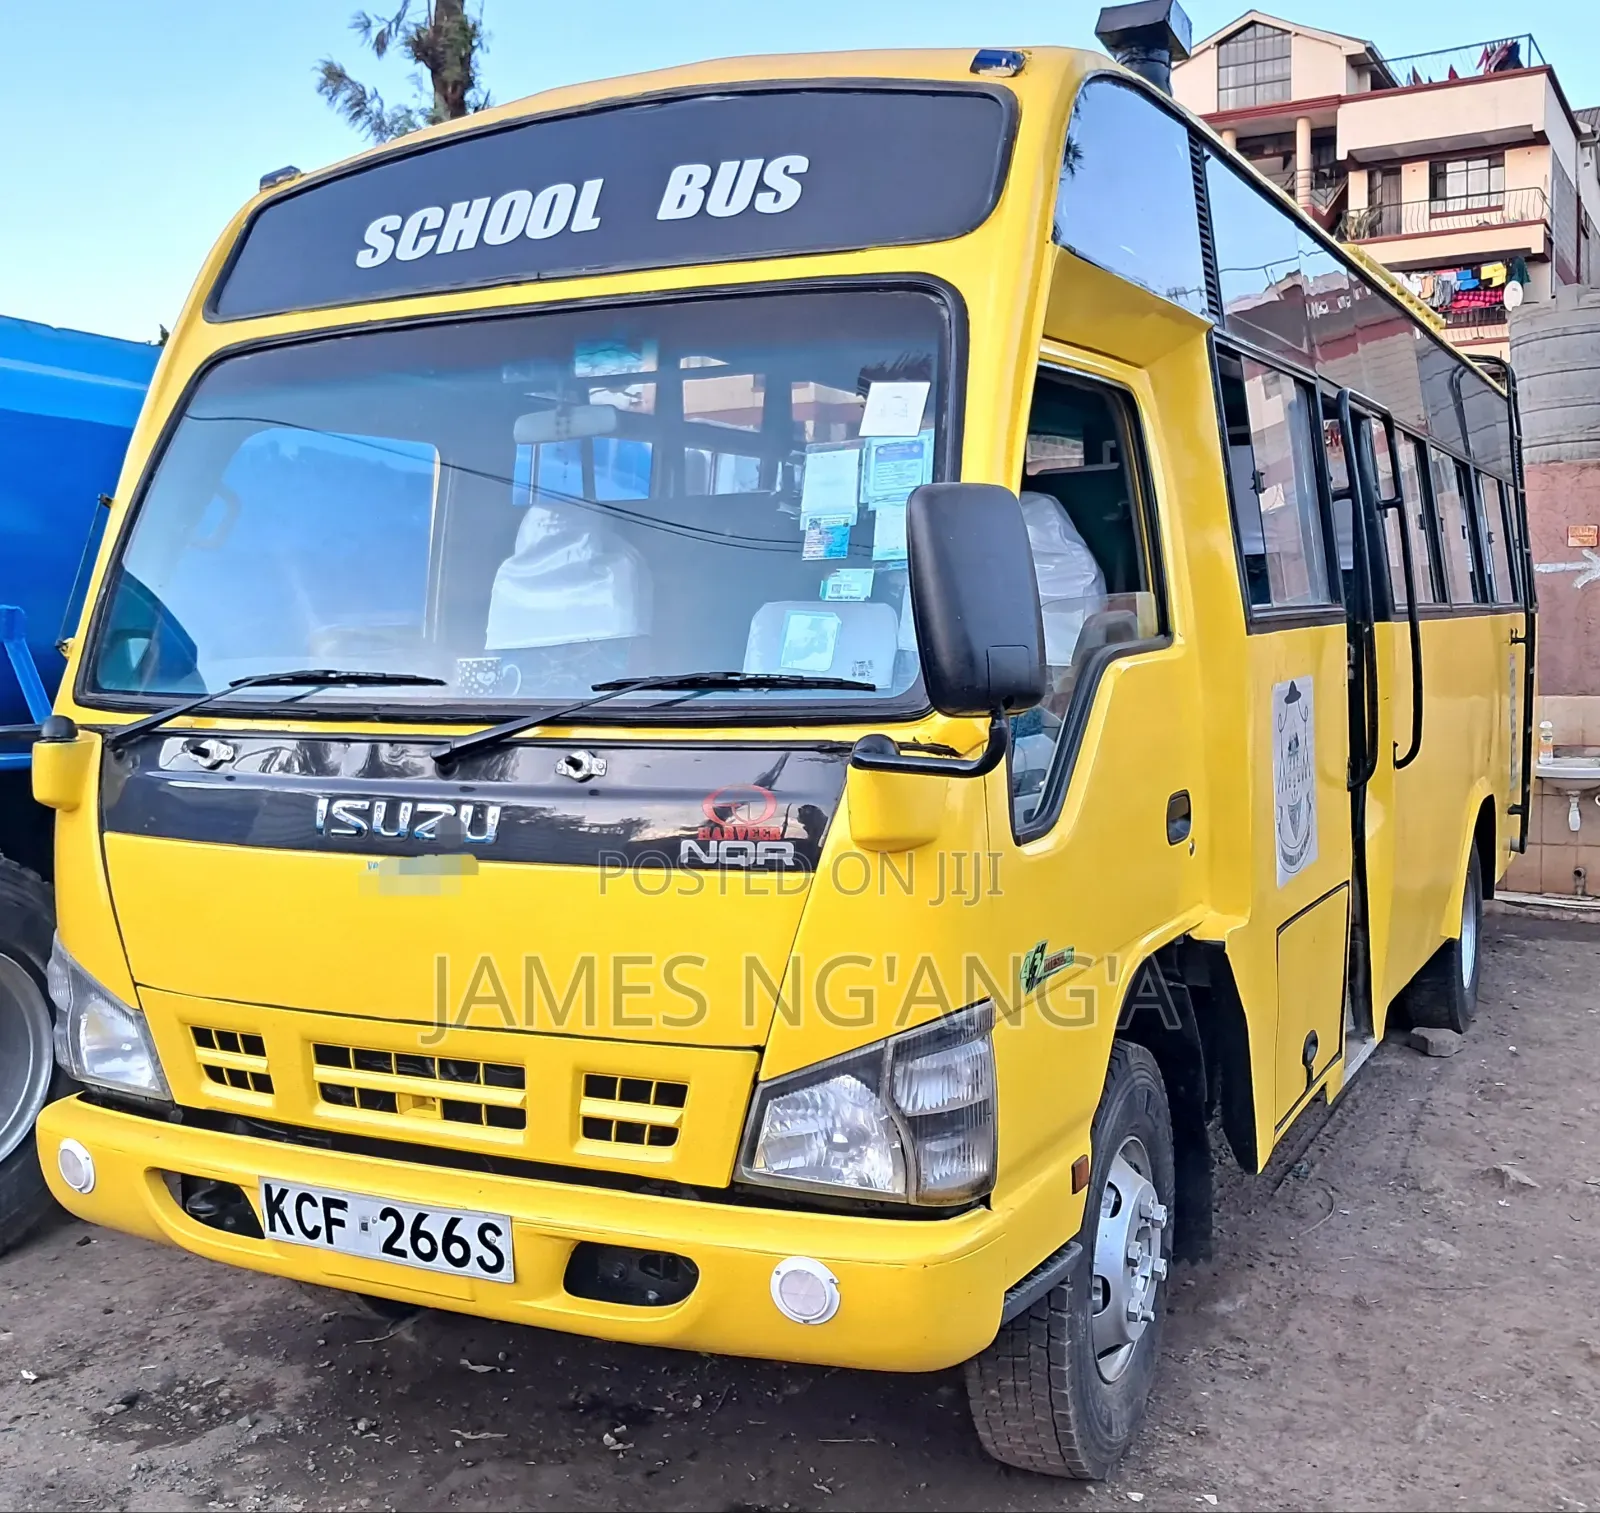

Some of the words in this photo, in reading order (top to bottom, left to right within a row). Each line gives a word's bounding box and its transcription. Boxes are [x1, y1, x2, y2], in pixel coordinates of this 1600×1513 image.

[355, 178, 605, 269] SCHOOL
[656, 155, 809, 221] BUS
[315, 798, 502, 845] ISUZU
[680, 839, 795, 867] NQR
[264, 1183, 348, 1245] KCF
[379, 1206, 505, 1274] 266S
